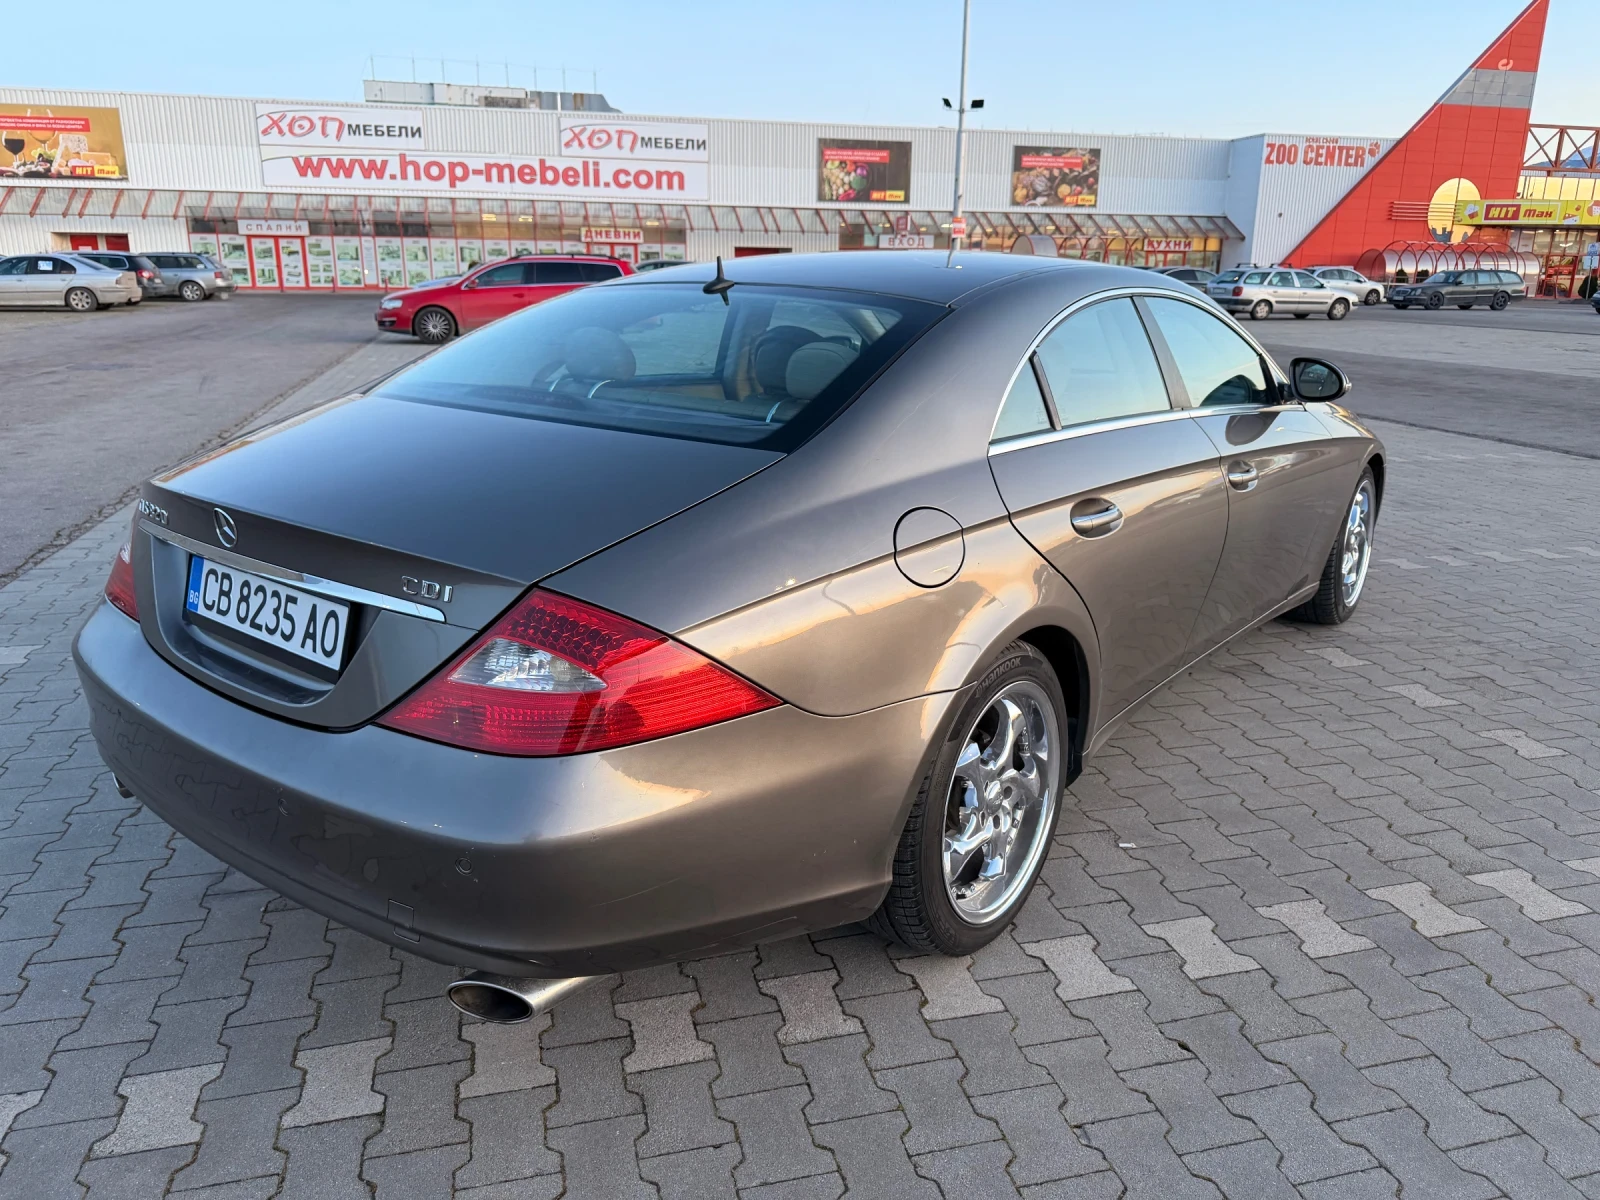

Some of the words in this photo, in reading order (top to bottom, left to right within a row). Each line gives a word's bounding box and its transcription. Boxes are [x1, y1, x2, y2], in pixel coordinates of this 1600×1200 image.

[347, 123, 422, 139] МЕБЕЛИ
[640, 136, 706, 151] МЕБЕЛИ
[1264, 143, 1299, 165] ZOO
[1302, 144, 1366, 168] CENTER
[75, 166, 93, 175] HIT
[291, 153, 686, 191] www.hop-mebeli.com
[1488, 207, 1517, 219] HIT
[245, 223, 302, 232] СПАЛНИ
[584, 228, 641, 240] ДНЕВНИ
[888, 237, 925, 249] ВХОД
[1147, 239, 1192, 249] КУХНИ
[189, 589, 200, 604] BG
[401, 575, 453, 603] CDI
[235, 579, 299, 643] 8235
